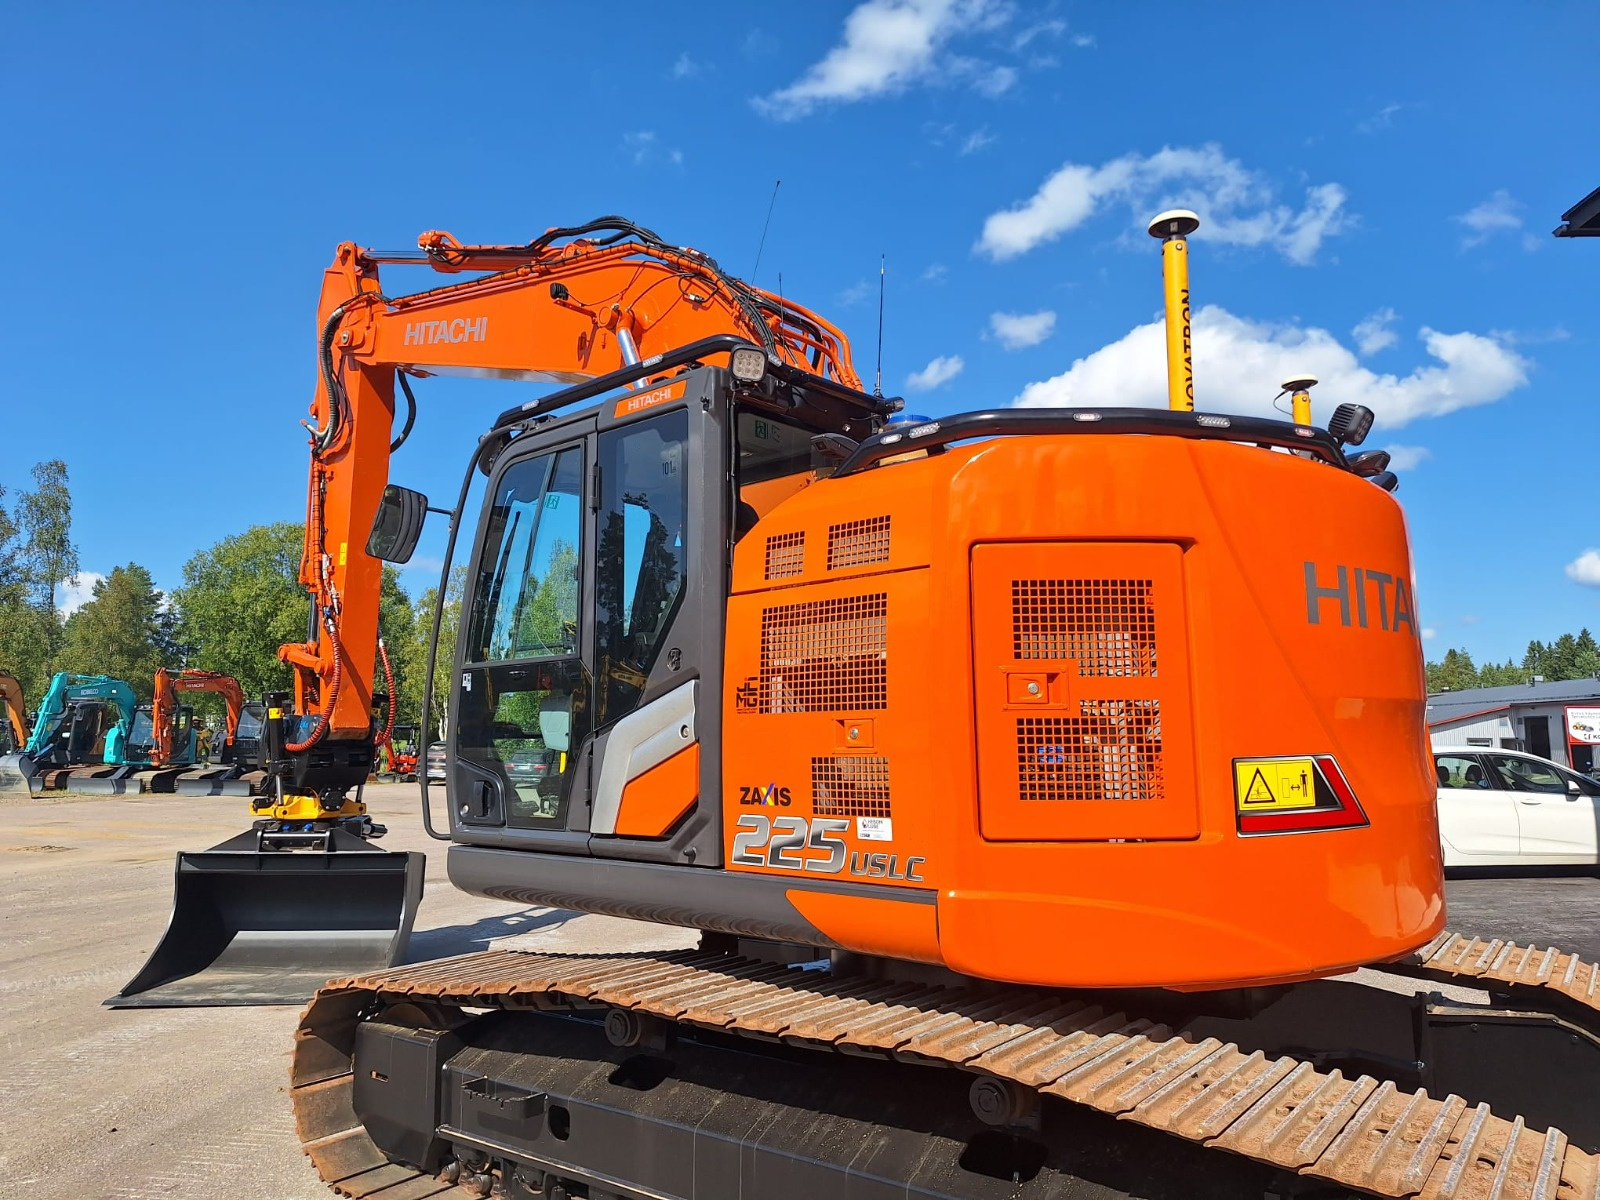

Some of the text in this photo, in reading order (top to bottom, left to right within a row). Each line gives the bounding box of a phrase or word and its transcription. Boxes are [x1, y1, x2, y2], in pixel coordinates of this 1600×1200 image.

[404, 317, 488, 346] HITACHI
[627, 387, 672, 411] HITACHI
[739, 782, 792, 807] ZAXIS
[731, 813, 926, 882] 225 USLC
